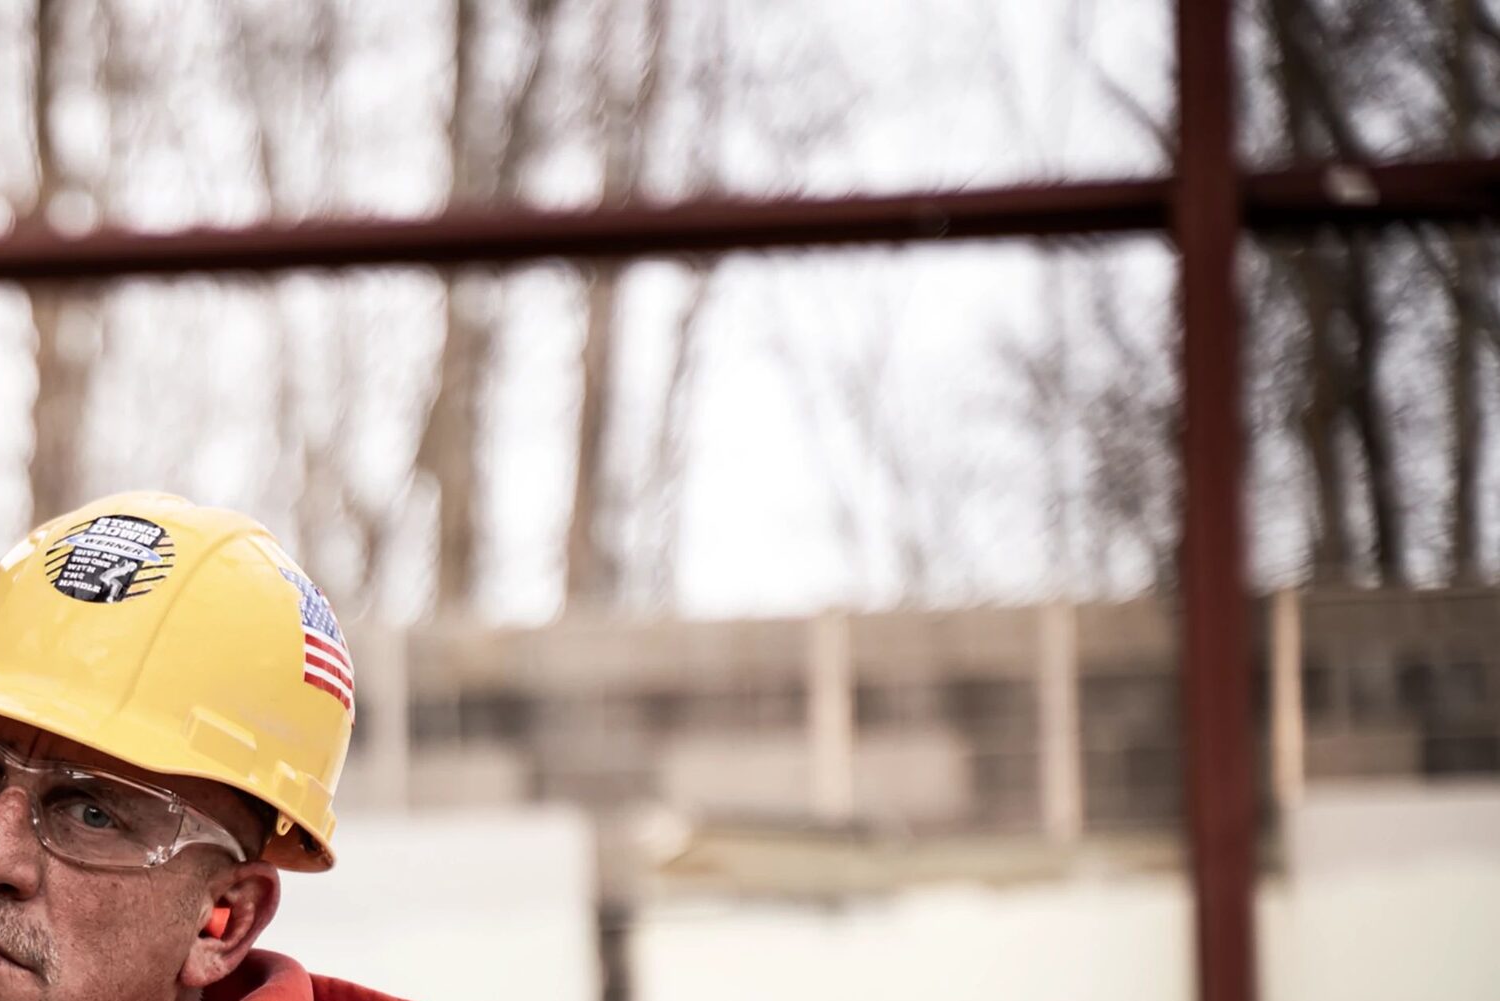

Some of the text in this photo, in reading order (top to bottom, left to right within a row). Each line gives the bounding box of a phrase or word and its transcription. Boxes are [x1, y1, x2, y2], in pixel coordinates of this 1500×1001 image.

[89, 525, 156, 546] DOWN
[84, 537, 144, 556] WERNER
[67, 563, 96, 573] WITH
